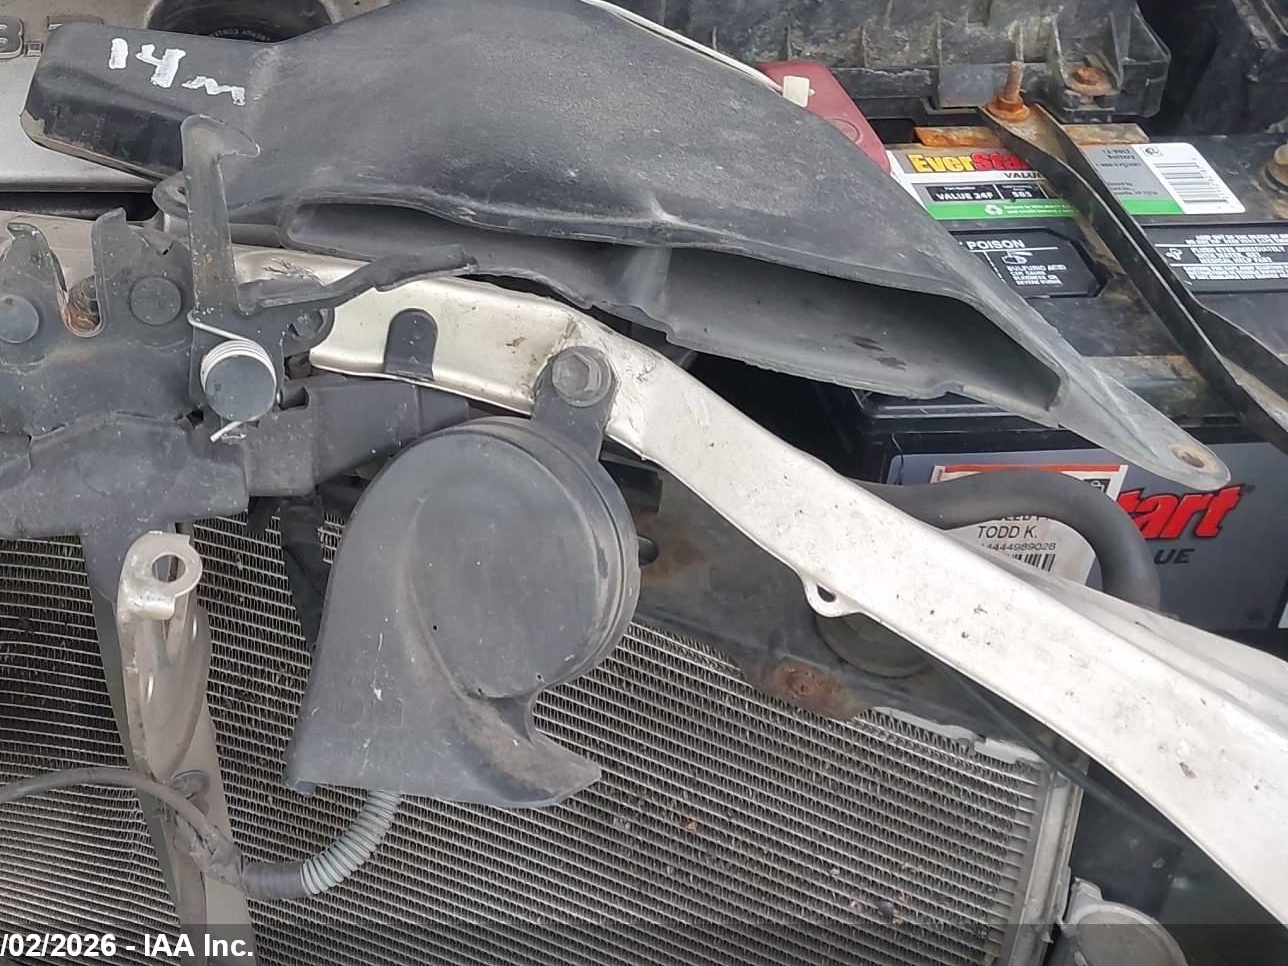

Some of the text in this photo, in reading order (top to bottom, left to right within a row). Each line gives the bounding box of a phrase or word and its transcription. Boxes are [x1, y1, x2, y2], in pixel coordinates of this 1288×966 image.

[907, 153, 1032, 172] EverSta
[966, 240, 1025, 250] POISON
[977, 525, 1037, 538] TODD K.
